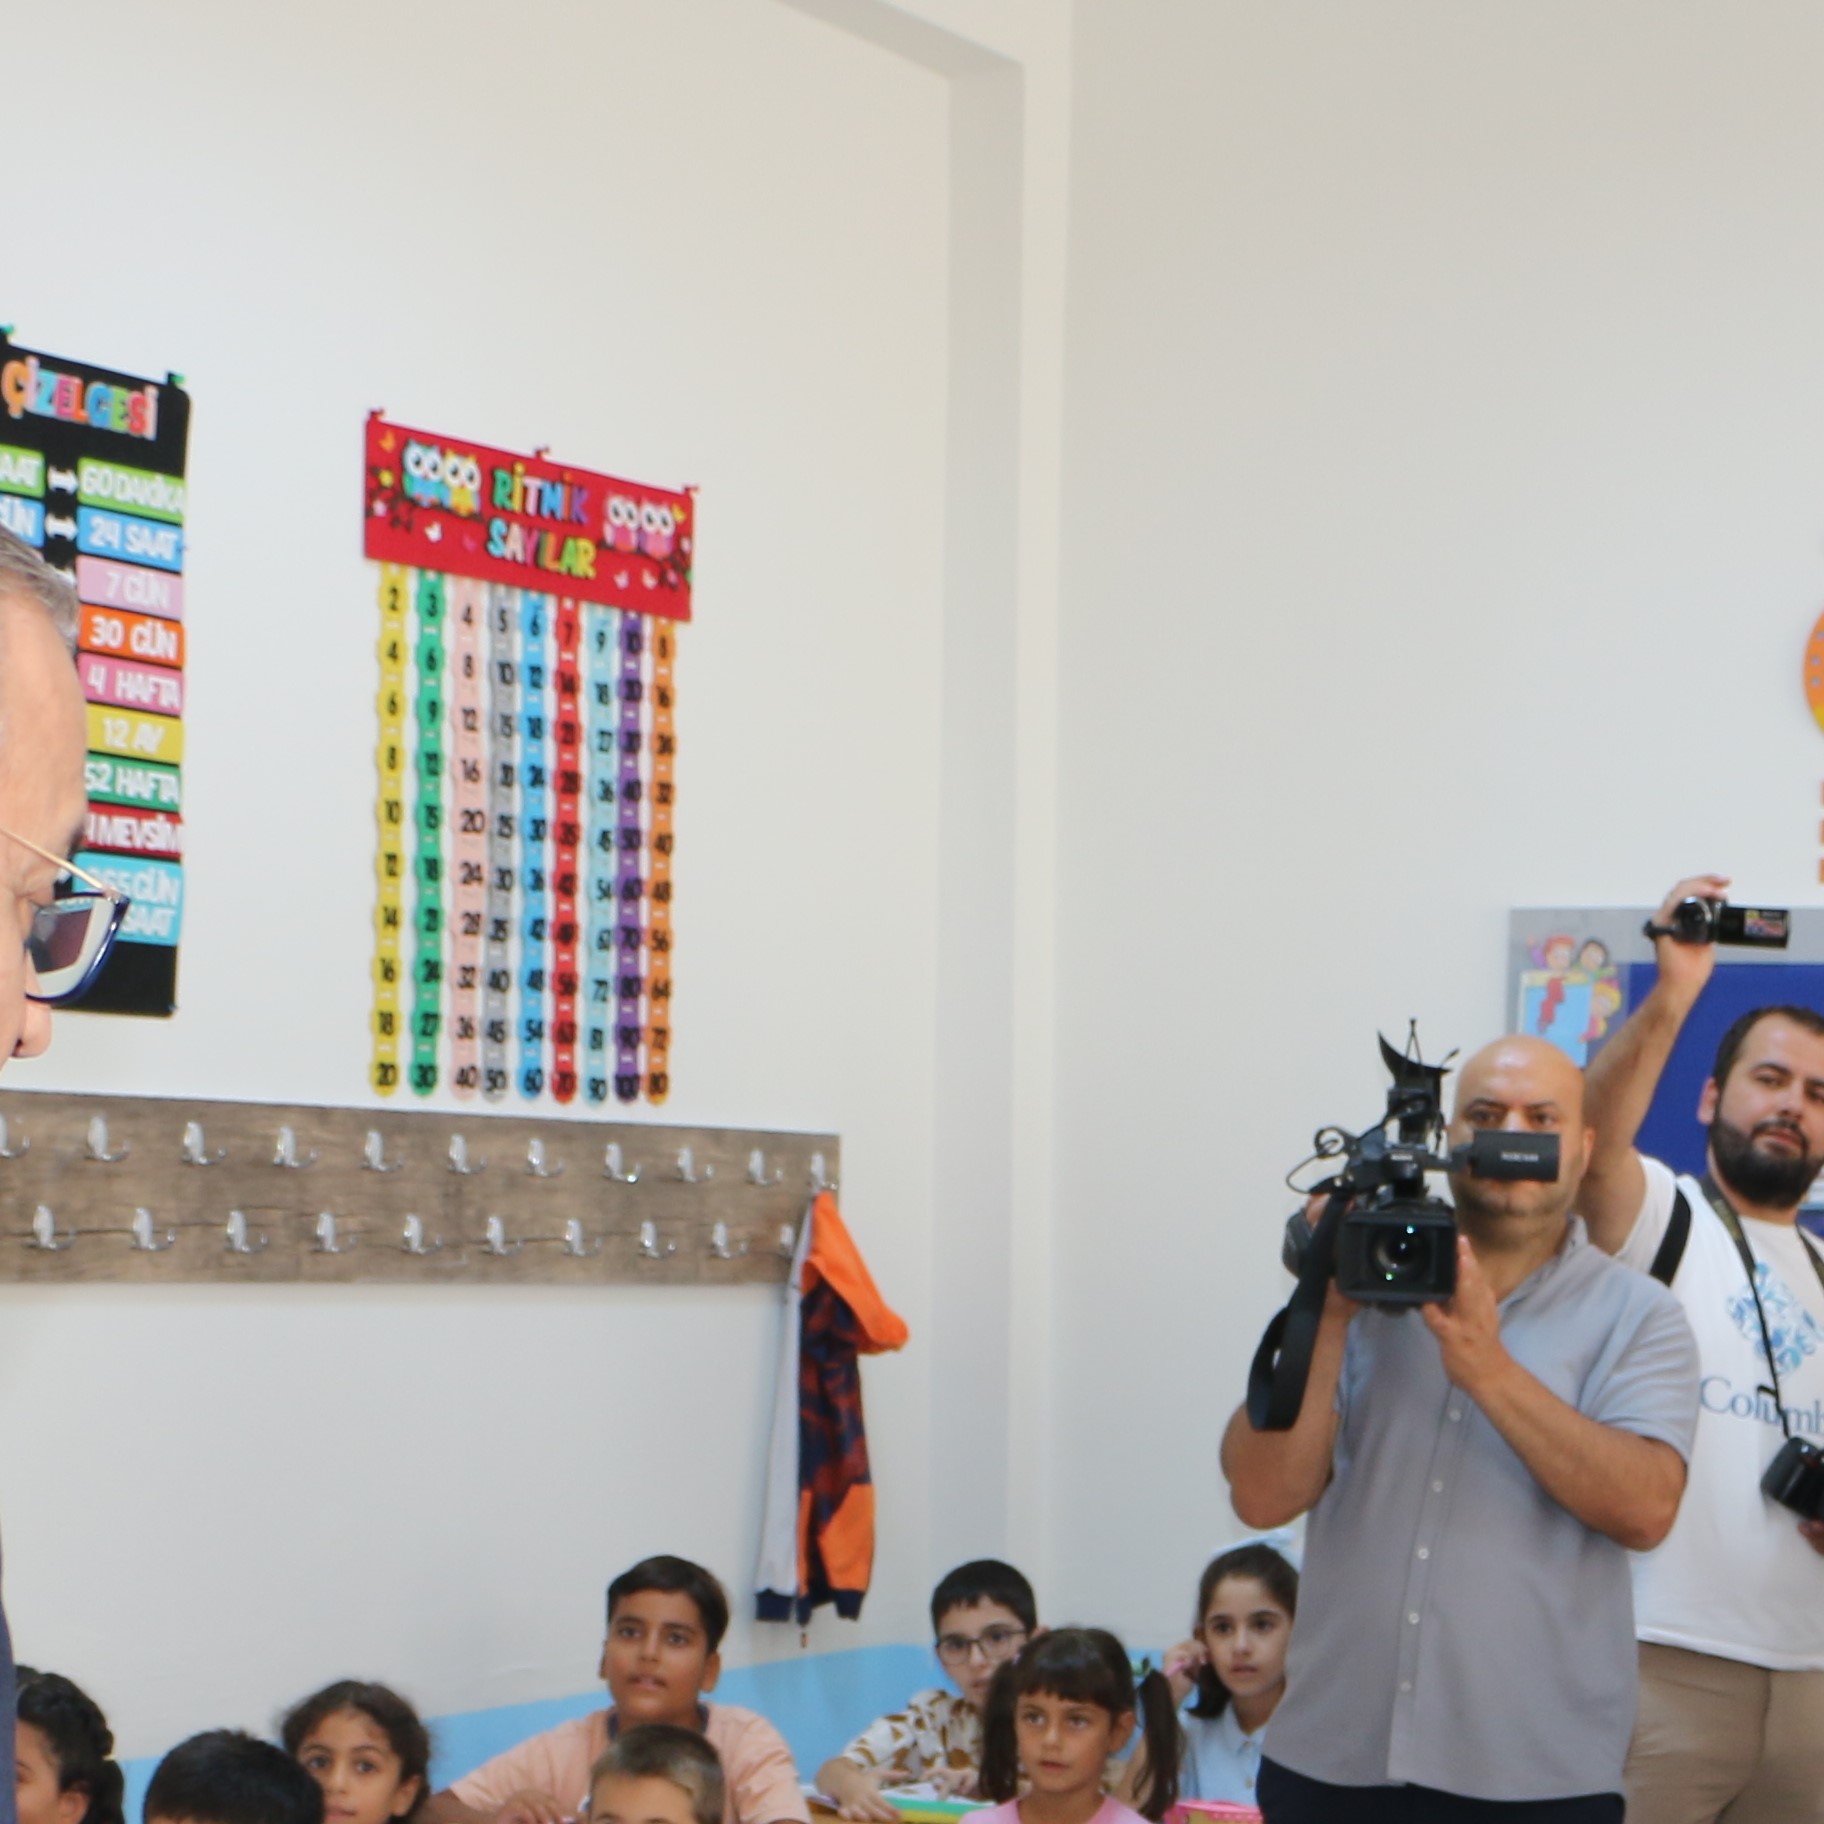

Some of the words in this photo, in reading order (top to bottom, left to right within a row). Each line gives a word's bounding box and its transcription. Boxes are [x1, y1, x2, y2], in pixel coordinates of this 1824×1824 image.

[0, 355, 160, 441] ÇİZELGESİ
[81, 465, 113, 497] 60
[493, 461, 589, 526] RİTMİK
[90, 515, 121, 547] 24
[126, 525, 179, 562] SAAT
[486, 517, 597, 580] SAYILAR
[106, 570, 119, 599] 7
[124, 573, 171, 610] GÜN
[389, 586, 399, 611] 2
[462, 604, 473, 627] 4
[498, 608, 508, 633] 5
[531, 612, 541, 637] 6
[89, 615, 125, 648] 30
[130, 621, 179, 659] GÜN
[387, 641, 399, 663] 4
[463, 654, 473, 678] 8
[499, 660, 514, 686] 10
[88, 664, 105, 694] 4
[114, 669, 182, 711] HAFTA
[102, 717, 128, 749] 12
[85, 763, 112, 792] 52
[115, 766, 180, 804] HAFTA
[461, 759, 481, 785] 16
[386, 800, 400, 825] 10
[461, 809, 485, 835] 20
[497, 814, 514, 839] 25
[530, 818, 546, 843] 30
[132, 866, 180, 902] GÜN
[459, 862, 482, 886] 24
[497, 868, 513, 893] 30
[488, 969, 510, 993] 40
[457, 1016, 474, 1041] 36
[525, 1019, 544, 1042] 54
[456, 1065, 477, 1090] 40
[485, 1069, 507, 1093] 50
[525, 1069, 544, 1094] 60
